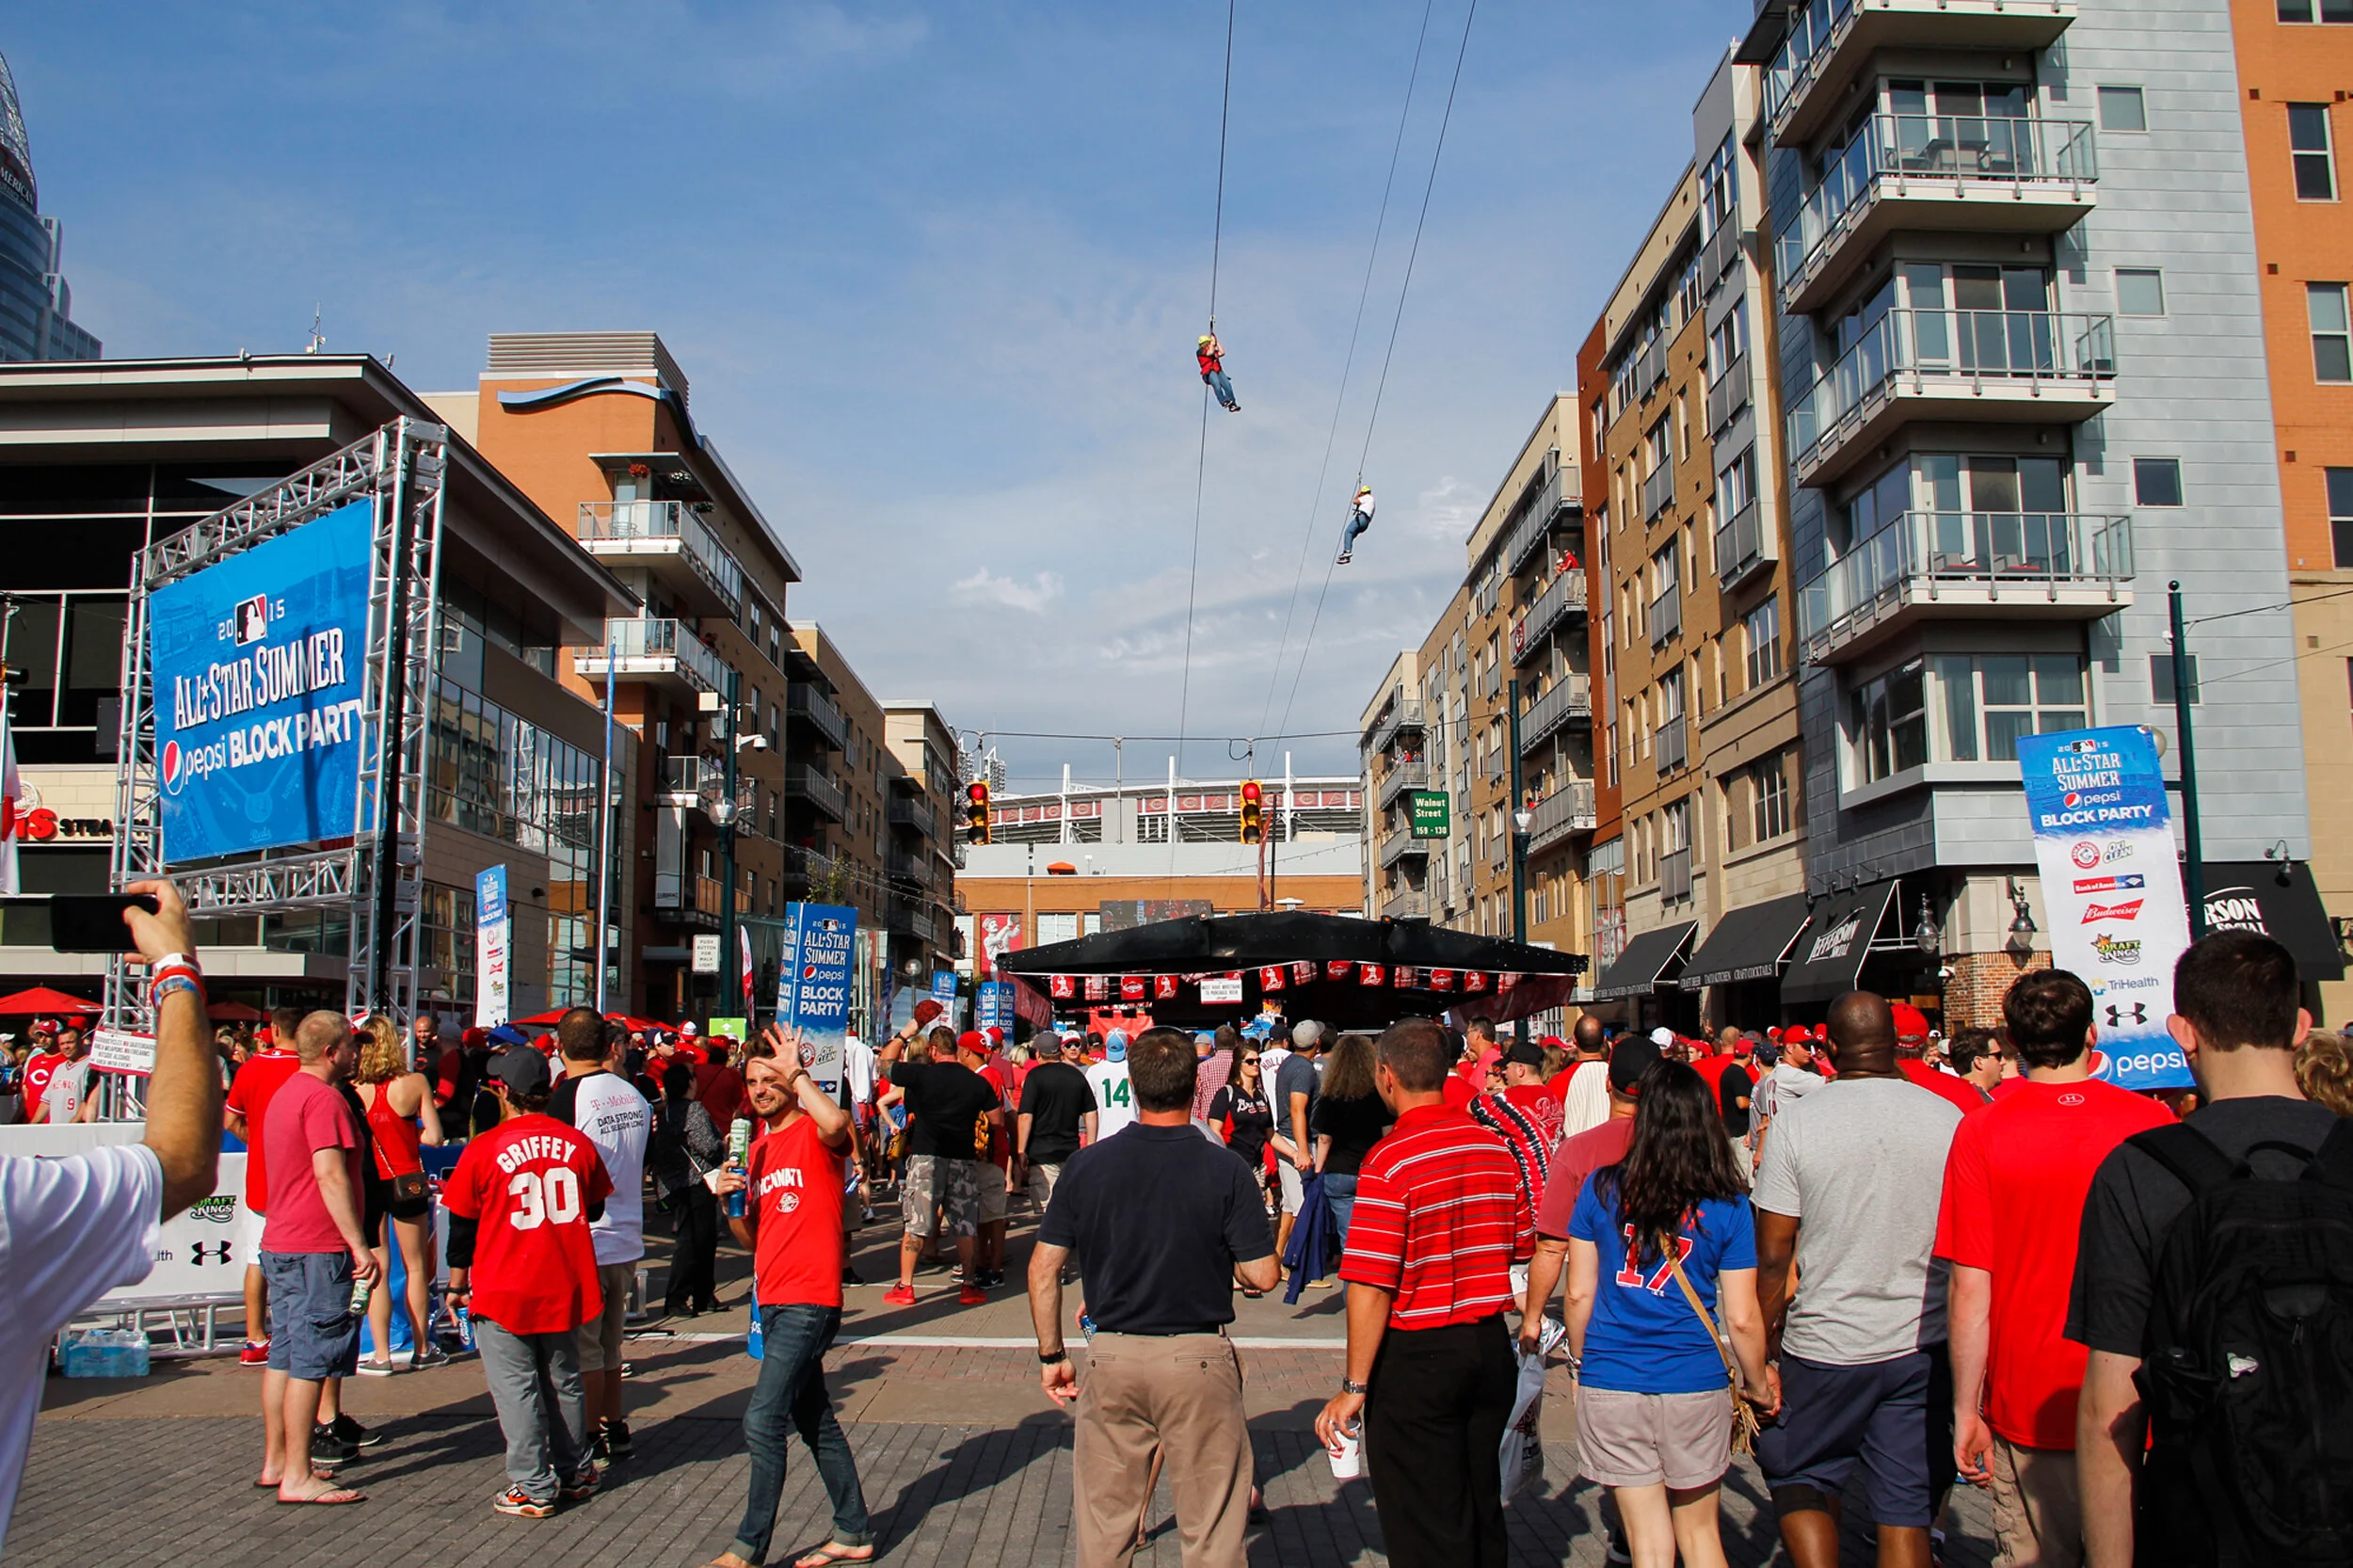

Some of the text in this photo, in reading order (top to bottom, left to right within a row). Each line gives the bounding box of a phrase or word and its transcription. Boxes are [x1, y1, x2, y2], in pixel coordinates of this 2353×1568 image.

[218, 599, 286, 641] 20 15
[254, 627, 346, 707] SUMMER
[184, 734, 228, 785] pepsi
[229, 715, 295, 769] BLOCK
[2057, 771, 2121, 792] SUMMER
[1415, 798, 1446, 807] Walnut
[2084, 791, 2121, 807] pepsi
[1416, 808, 1442, 817] Street
[2041, 805, 2153, 827] BLOCK PARTY
[2085, 906, 2140, 919] Budweiser
[2100, 940, 2141, 952] DRAFT
[805, 947, 847, 966] SUMMER
[2100, 949, 2141, 961] KINGS
[818, 969, 845, 982] pepsi
[2107, 977, 2159, 990] TriHealth
[801, 985, 844, 1001] BLOCK
[799, 1000, 844, 1016] PARTY
[2117, 1050, 2189, 1078] pepsi
[29, 1068, 50, 1085] C
[1101, 1078, 1129, 1108] 14
[67, 1097, 75, 1111] 9
[1237, 1098, 1267, 1112] Bra
[598, 1110, 644, 1128] DATA STRONG
[496, 1135, 577, 1174] GRIFFEY
[507, 1166, 581, 1231] 30
[191, 1205, 233, 1219] KINGS
[1615, 1223, 1693, 1292] 17
